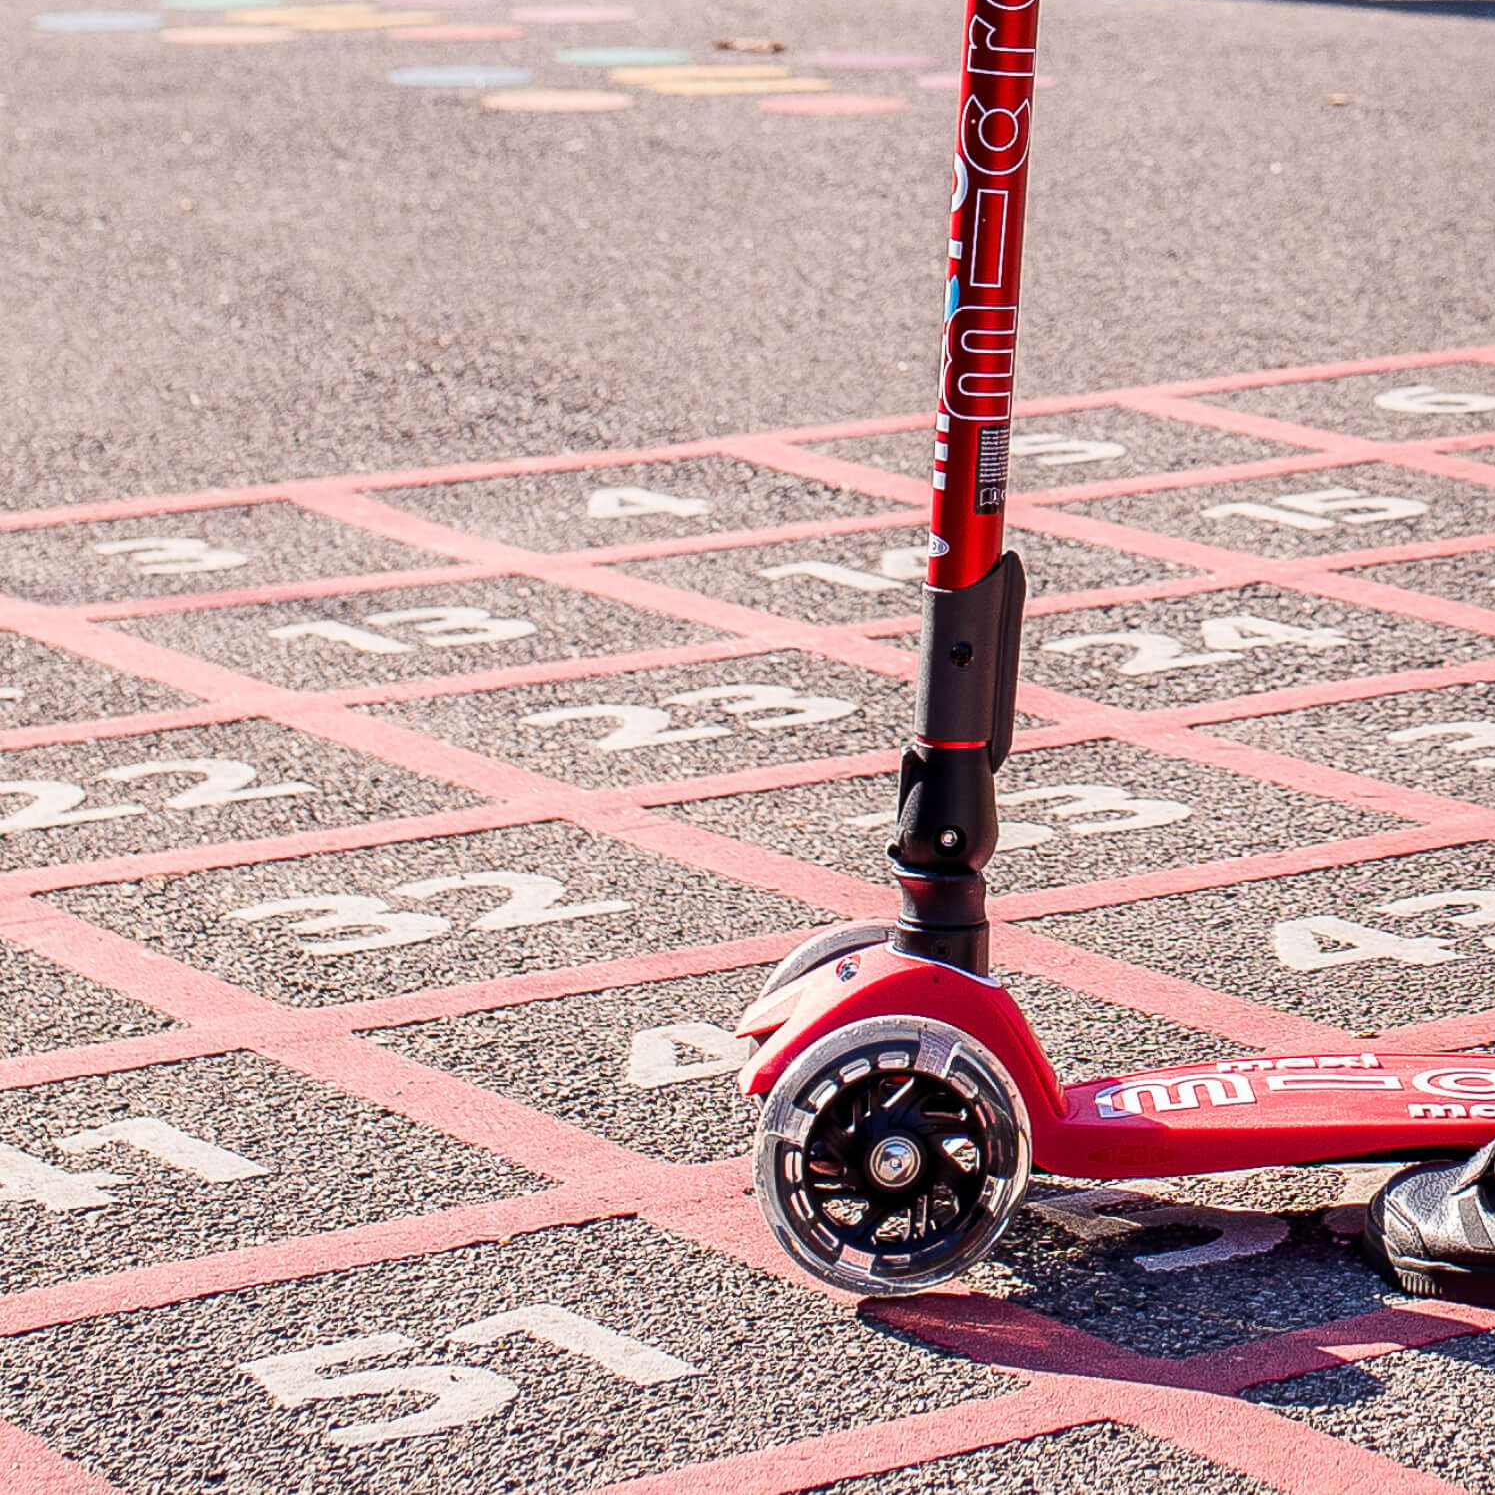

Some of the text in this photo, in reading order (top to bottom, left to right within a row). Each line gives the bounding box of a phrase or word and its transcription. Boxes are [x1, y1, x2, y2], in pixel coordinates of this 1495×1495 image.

[1008, 432, 1127, 467] 5
[588, 487, 710, 518] 4
[1204, 488, 1430, 530] 15
[95, 536, 250, 574] 3
[267, 606, 538, 655] 13
[1044, 615, 1352, 676] 24
[520, 683, 858, 752] 23
[227, 871, 636, 955] 32
[245, 1304, 700, 1444] 51
